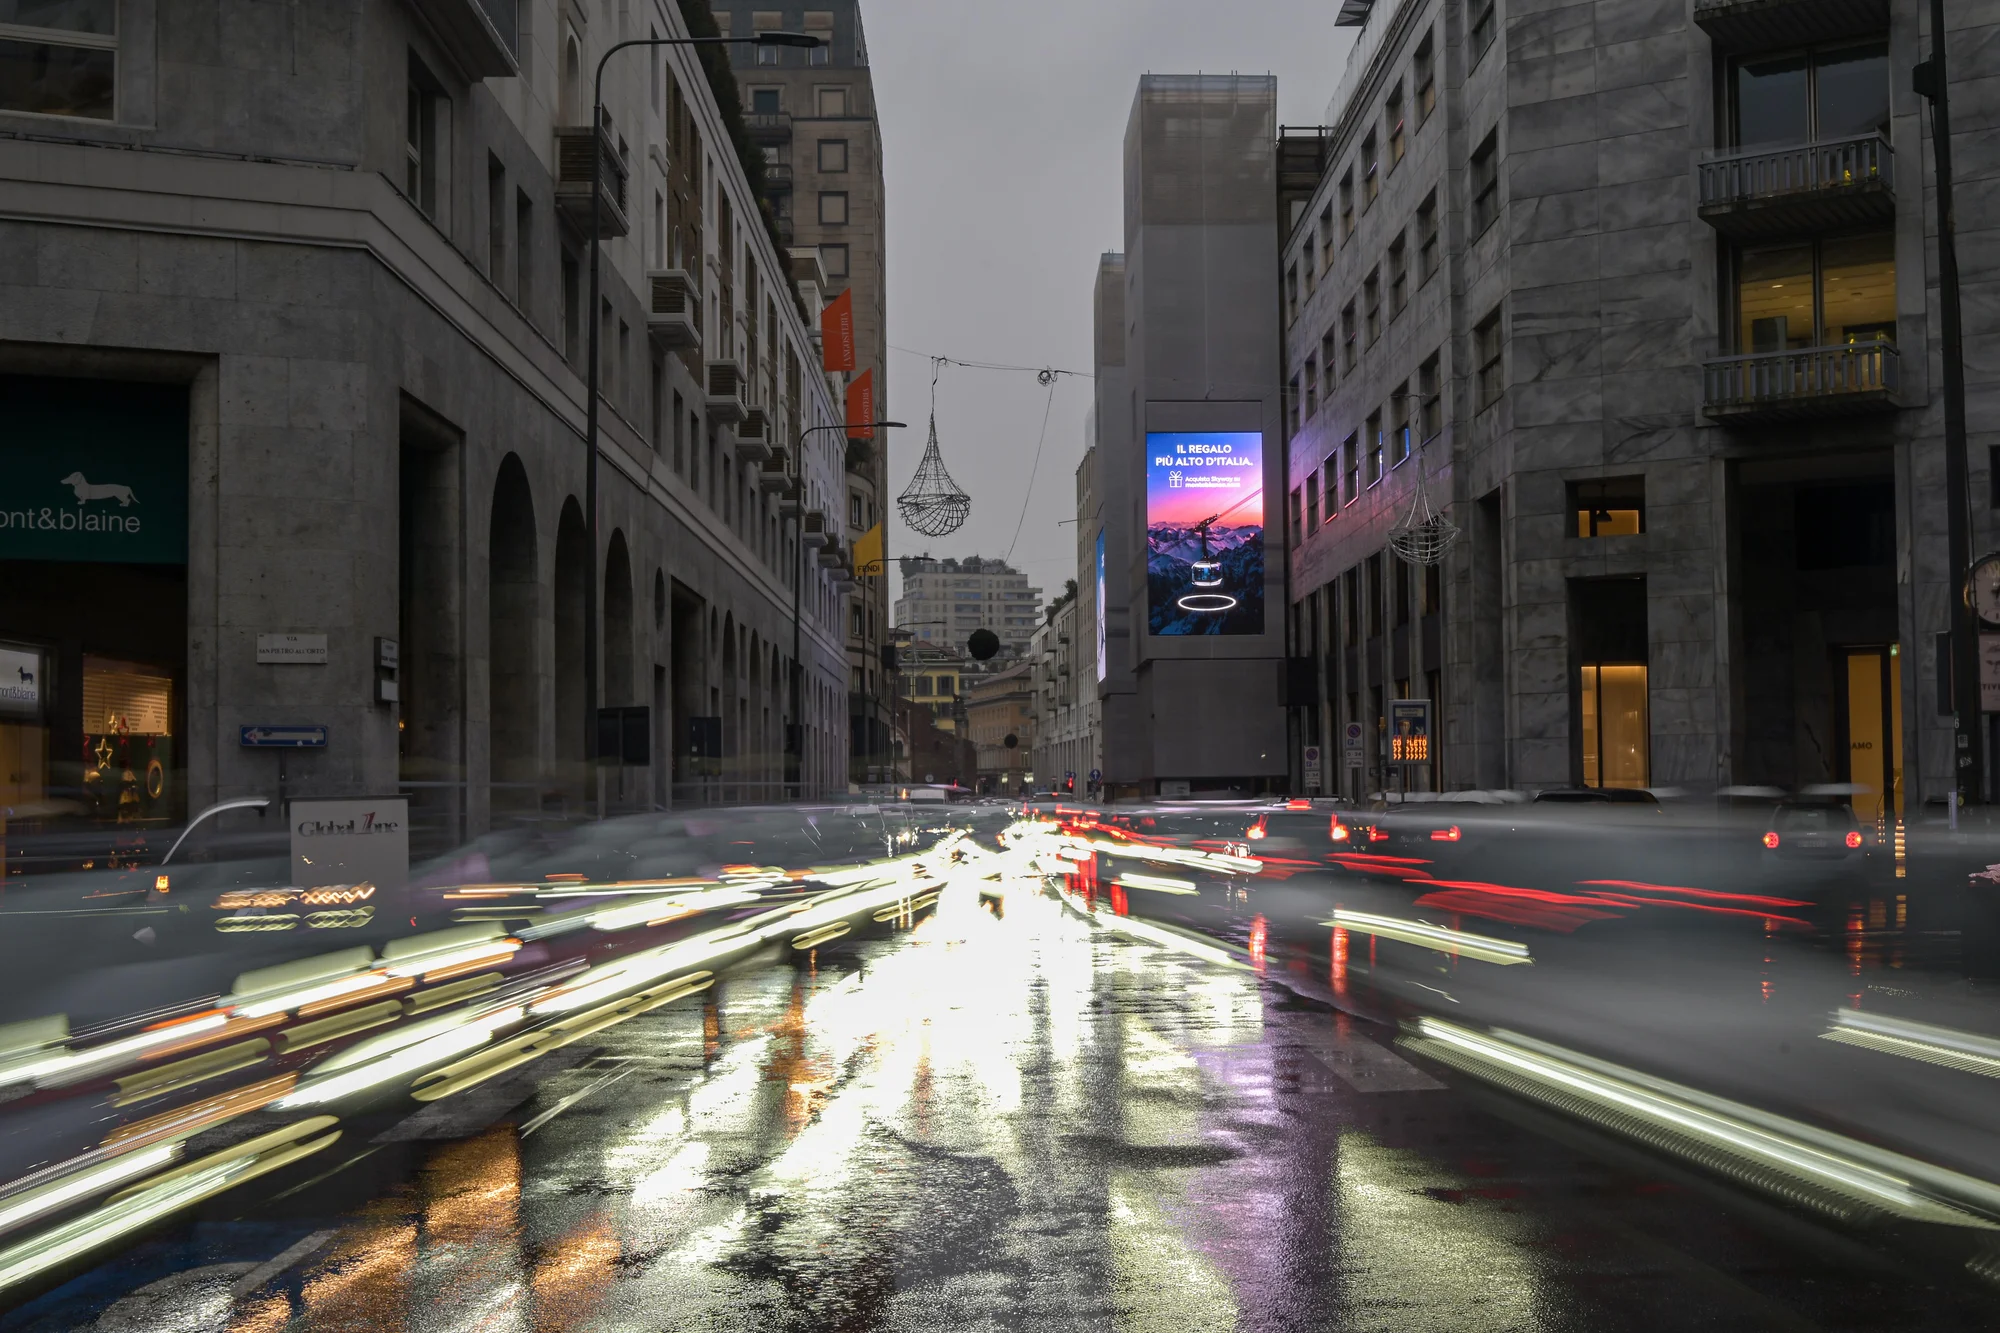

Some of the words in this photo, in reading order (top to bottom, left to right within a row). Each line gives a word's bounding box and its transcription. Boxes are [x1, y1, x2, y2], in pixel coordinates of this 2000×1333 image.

[840, 312, 852, 367] LANGOSTERIA
[1177, 444, 1186, 454] IL
[1189, 444, 1232, 454] REGALO
[1155, 455, 1173, 466] PIÙ
[1175, 457, 1204, 466] ALTO
[857, 564, 880, 573] FENDI
[298, 820, 354, 837] Global
